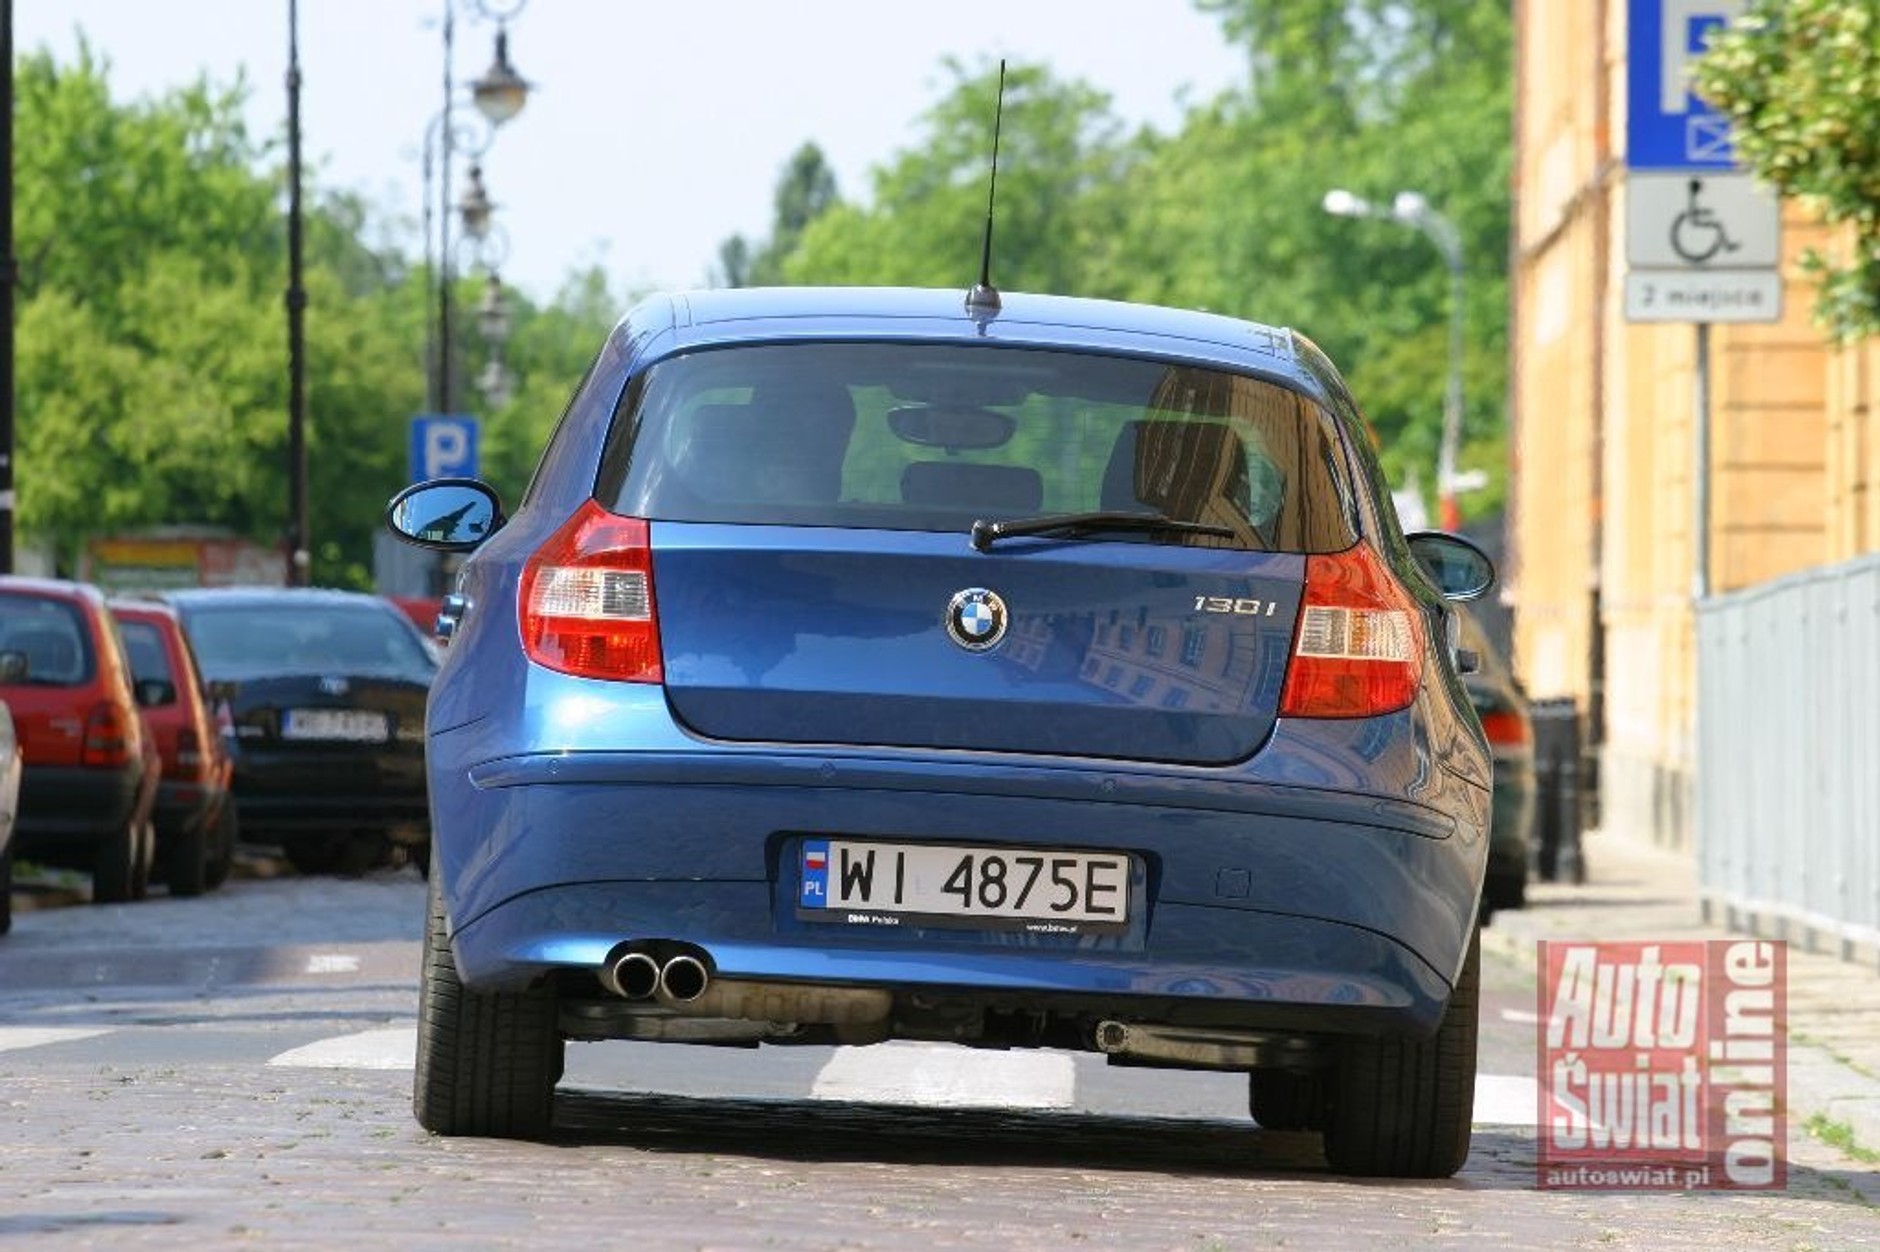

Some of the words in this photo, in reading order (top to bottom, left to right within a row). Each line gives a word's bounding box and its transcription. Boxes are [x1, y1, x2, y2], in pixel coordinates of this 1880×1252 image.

[1642, 283, 1655, 308] 2
[426, 422, 468, 478] P
[804, 881, 824, 896] PL
[940, 854, 1118, 914] 4875E
